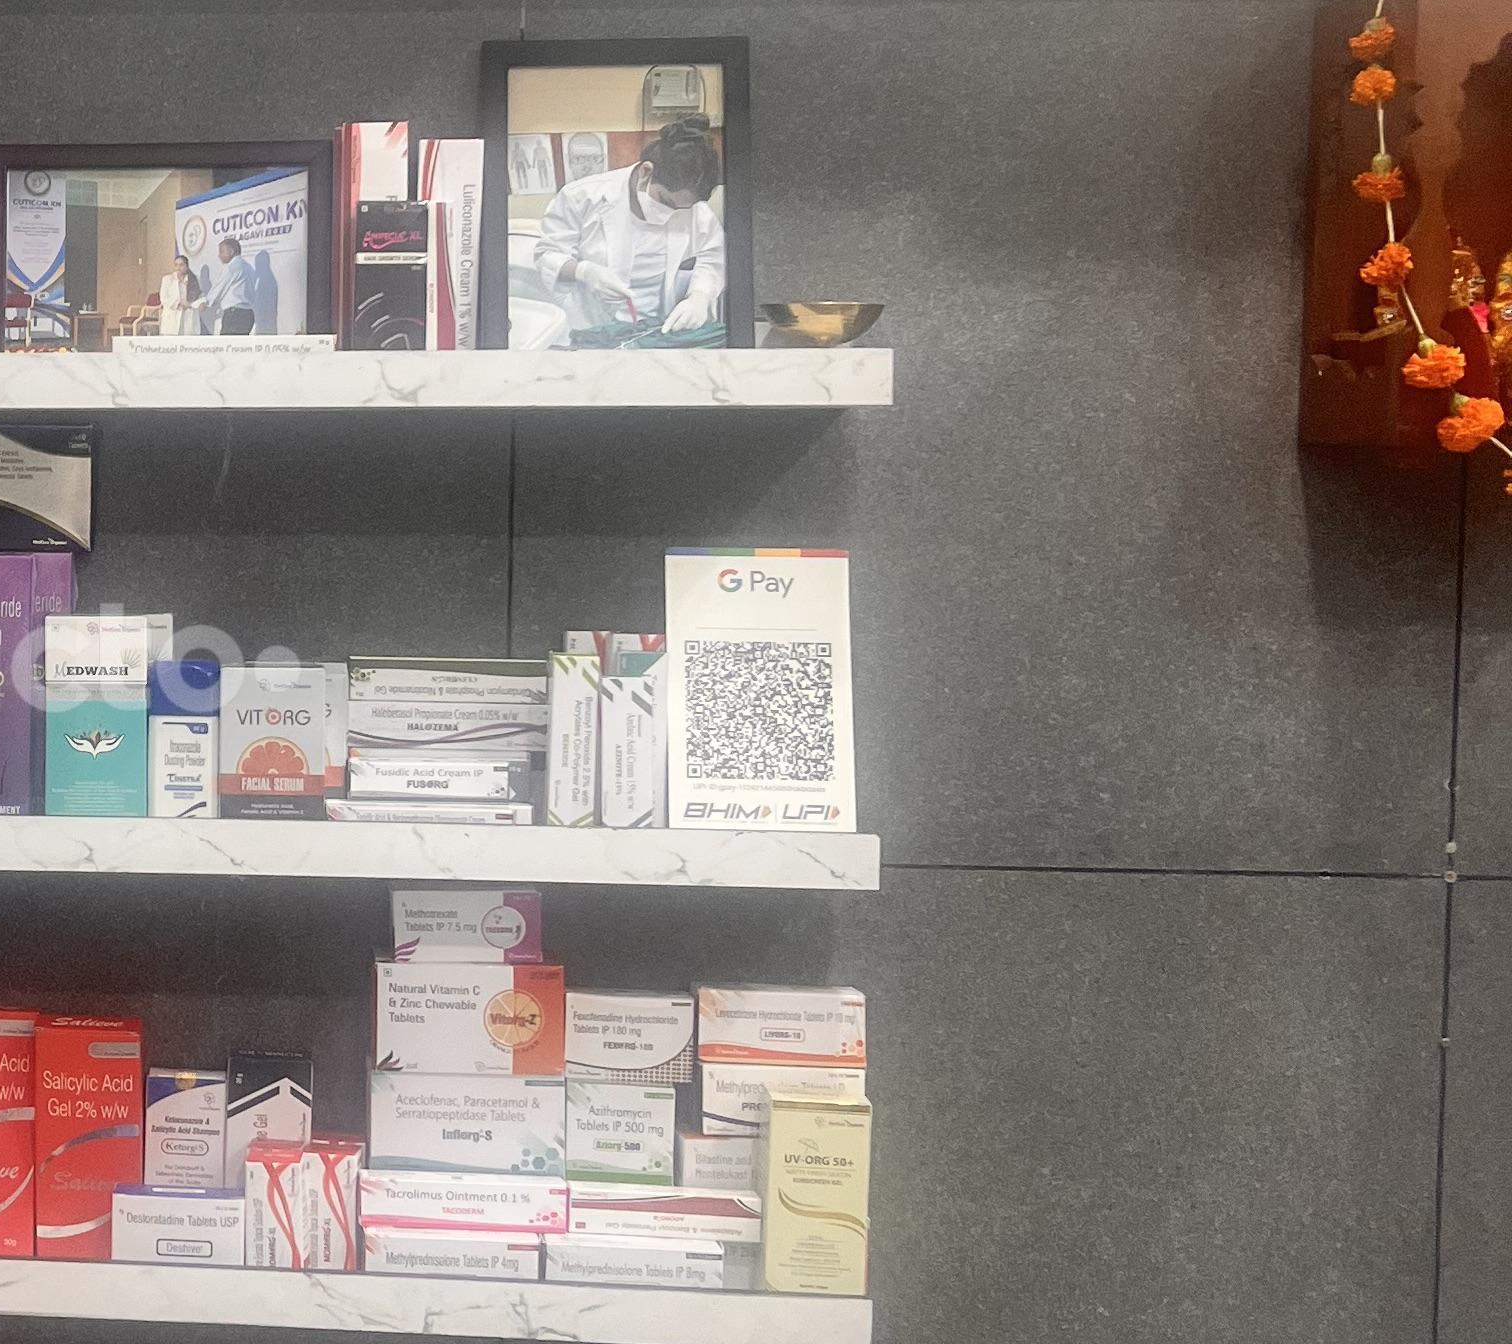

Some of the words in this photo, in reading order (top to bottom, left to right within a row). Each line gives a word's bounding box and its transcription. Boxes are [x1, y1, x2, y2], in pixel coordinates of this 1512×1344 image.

[213, 204, 280, 236] CUTICON
[461, 183, 477, 258] Luliconazole
[460, 259, 474, 297] Cream
[459, 303, 472, 320] 1%
[717, 568, 743, 593] G
[749, 569, 794, 597] Pay
[237, 707, 311, 726] VITORG
[454, 709, 477, 720] Cream
[375, 767, 409, 777] Fusidic
[413, 767, 435, 777] Acid
[437, 768, 471, 777] Cream
[474, 768, 484, 777] IP
[241, 777, 272, 791] FACIAL
[273, 777, 305, 792] SERUM
[683, 802, 761, 819] BHIM
[782, 803, 831, 821] UPI
[405, 921, 434, 932] Tablets
[463, 923, 477, 934] mg
[388, 983, 427, 995] Natural
[429, 984, 469, 996] Vitamin
[472, 985, 480, 996] C
[389, 998, 396, 1008] &
[400, 997, 421, 1008] Zinc
[425, 998, 477, 1010] Chewable
[51, 1016, 124, 1027] Salieve
[389, 1012, 425, 1024] Tablets
[803, 1010, 825, 1022] Tablets
[573, 1023, 599, 1035] Tablets
[601, 1025, 610, 1035] IP
[630, 1027, 641, 1038] mg
[0, 1053, 30, 1073] Acid
[43, 1070, 98, 1095] Salicylic
[102, 1073, 134, 1092] Acid
[48, 1098, 71, 1117] Gel
[75, 1100, 97, 1119] 2%
[101, 1101, 128, 1119] w/w
[396, 1094, 459, 1107] Aceclofenac,
[464, 1095, 528, 1109] Paracetamol
[531, 1097, 540, 1109] &
[396, 1107, 487, 1123] Serratiopeptidase
[490, 1110, 526, 1122] Tablets
[588, 1105, 651, 1119] Azithromycin
[177, 1126, 190, 1135] Acid
[191, 1127, 220, 1137] Shampoo
[576, 1119, 610, 1132] Tablets
[612, 1120, 622, 1131] IP
[624, 1121, 645, 1133] 500
[647, 1124, 664, 1137] mg
[785, 1154, 830, 1166] UV-ORG
[832, 1157, 855, 1167] 50+
[386, 1188, 442, 1201] Tacrolimus
[446, 1190, 498, 1203] Ointment
[126, 1212, 185, 1226] Desloratadine
[188, 1214, 218, 1228] Tablets
[220, 1217, 240, 1228] USP
[386, 1252, 460, 1268] Methylprednisolone
[462, 1254, 489, 1268] Tablets
[491, 1255, 500, 1267] IP
[501, 1256, 519, 1271] 4mg
[561, 1261, 642, 1277] Methylprednisolone
[644, 1264, 673, 1277] Tablets
[675, 1266, 684, 1277] IP
